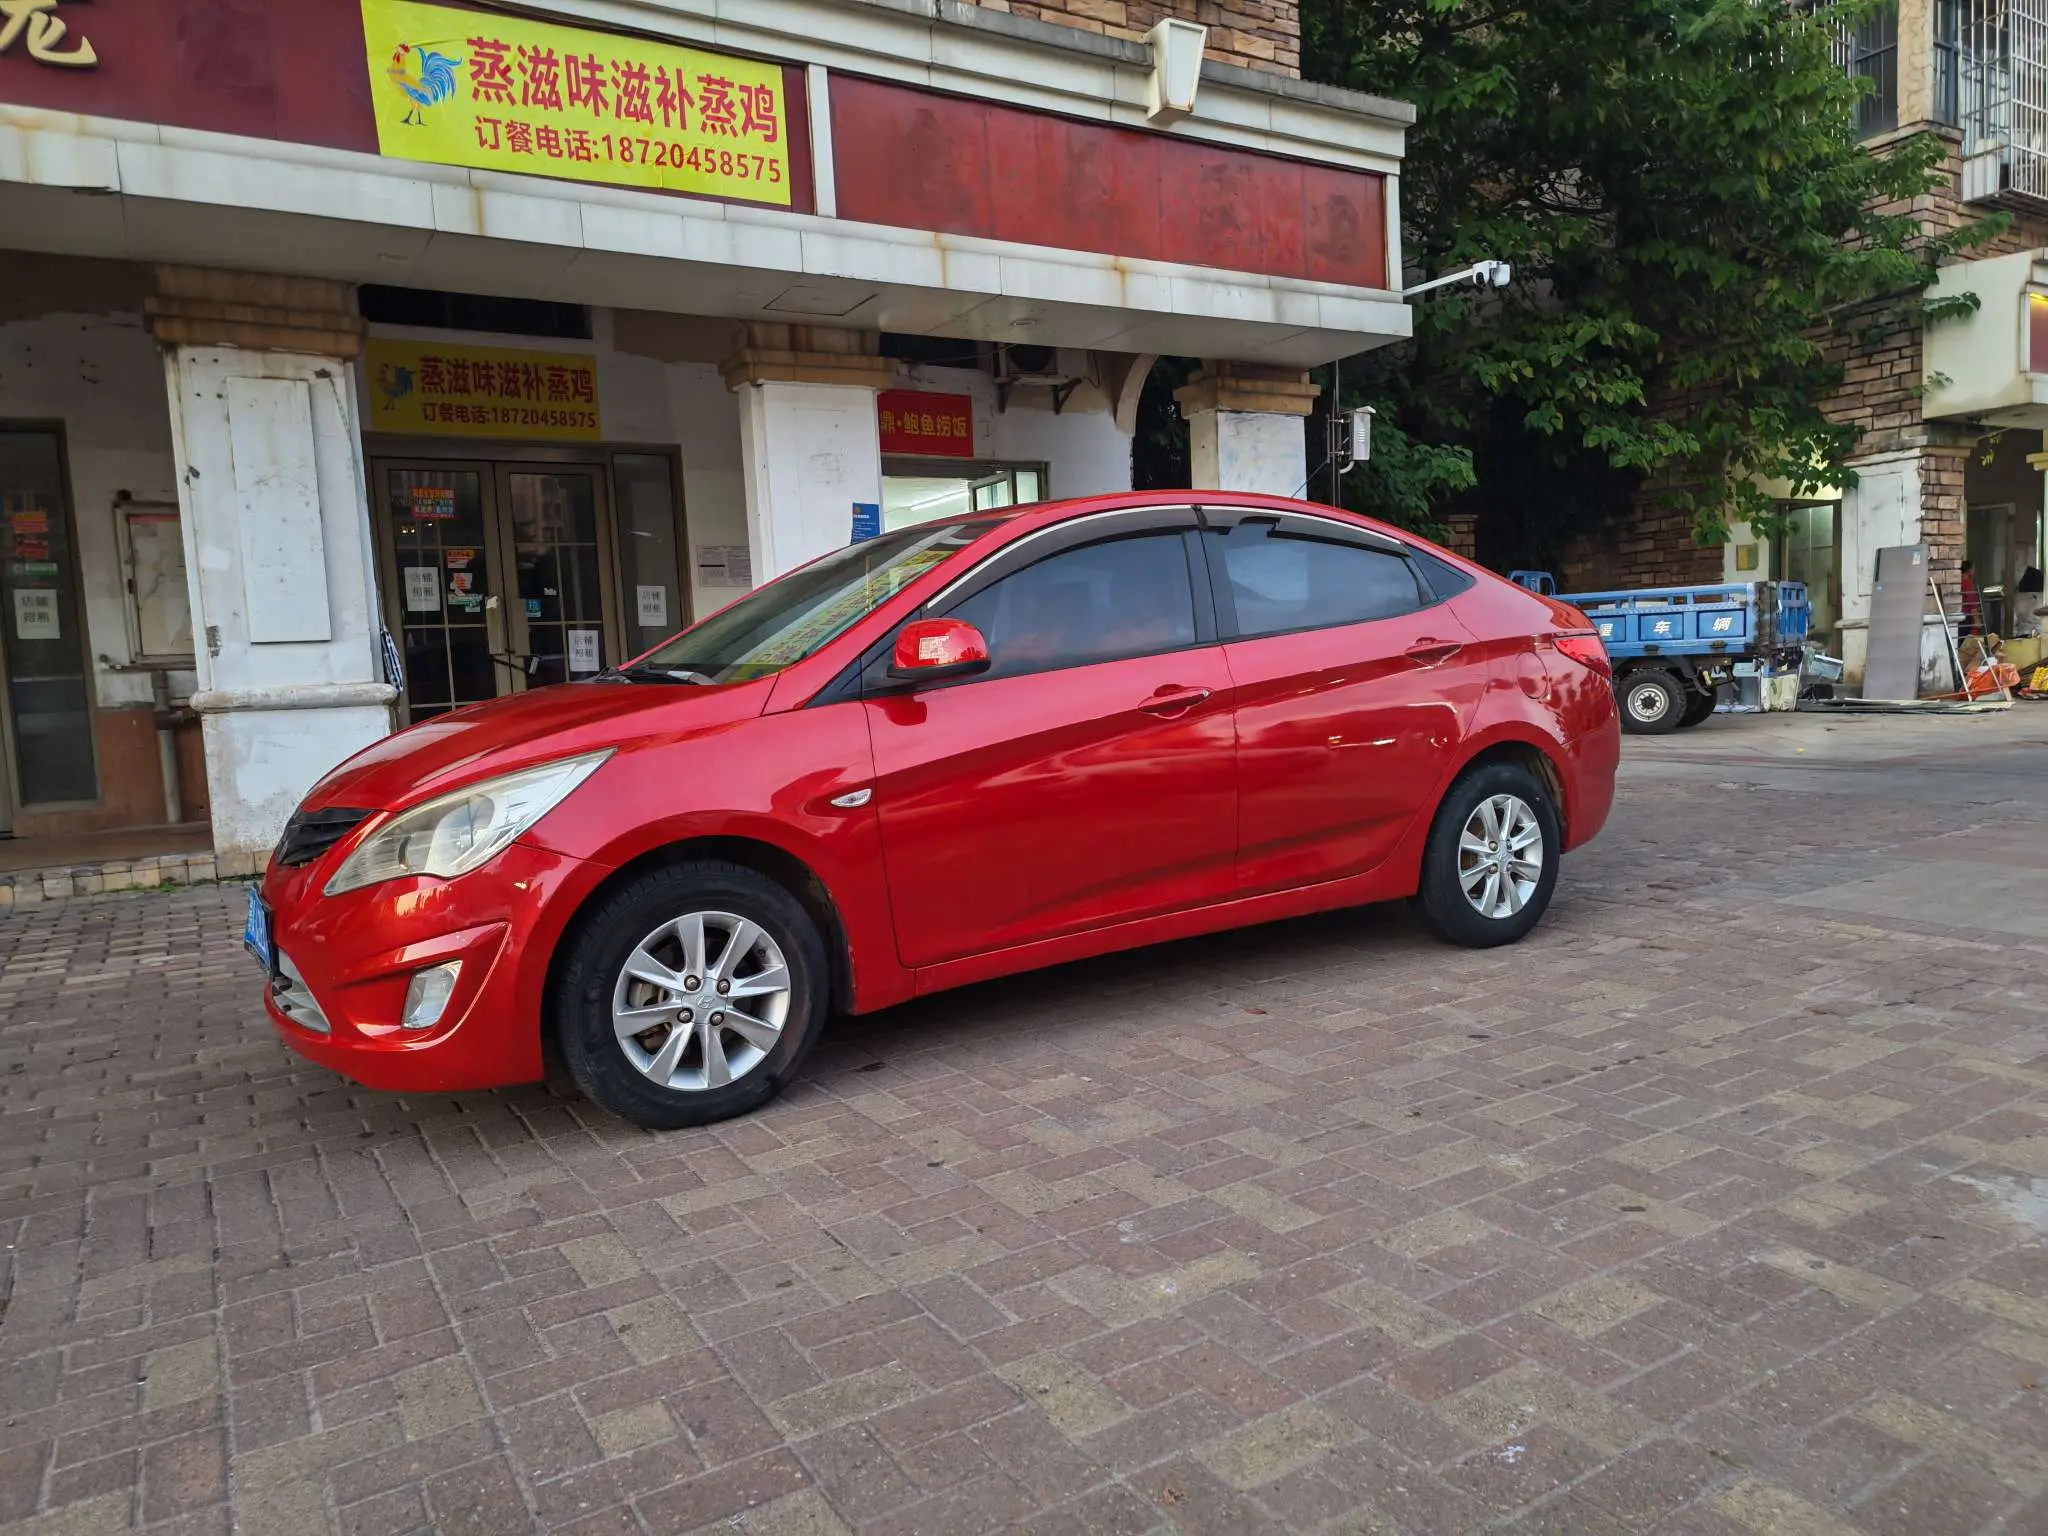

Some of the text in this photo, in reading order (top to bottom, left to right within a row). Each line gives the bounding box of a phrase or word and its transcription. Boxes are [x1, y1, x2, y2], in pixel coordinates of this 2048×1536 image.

[467, 36, 777, 143] 蒸滋味滋补蒸鸡
[474, 114, 781, 183] 订餐电话:18720458575
[419, 355, 593, 403] 蒸滋味滋补蒸鸡
[423, 403, 595, 428] 订餐电话:18720458575
